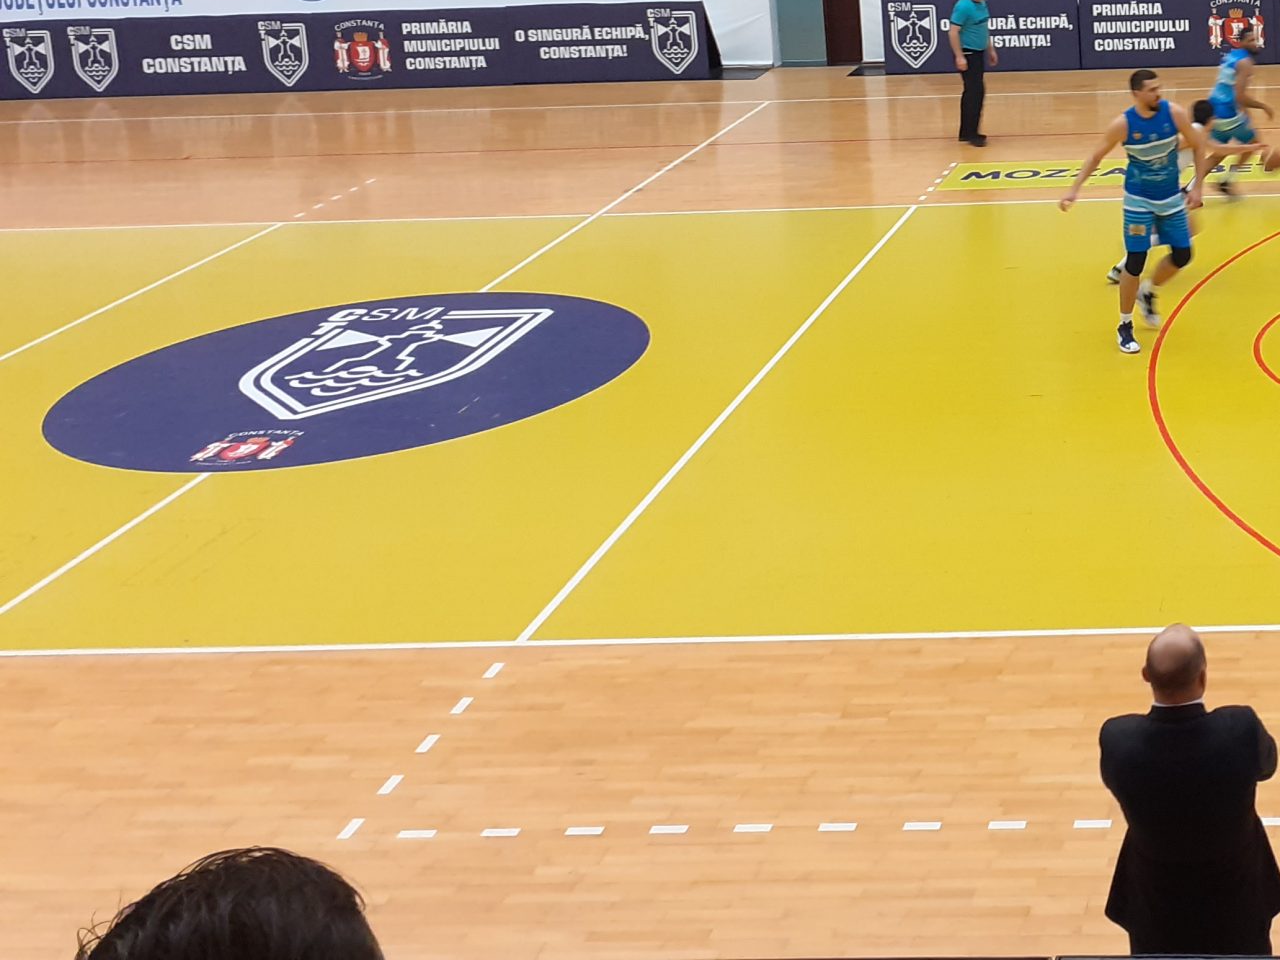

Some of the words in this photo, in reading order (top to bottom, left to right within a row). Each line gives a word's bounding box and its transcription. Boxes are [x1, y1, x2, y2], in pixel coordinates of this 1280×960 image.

[646, 8, 671, 18] CSM
[887, 2, 911, 12] CSM
[1092, 0, 1163, 17] PRIMĂRIA
[257, 21, 282, 31] CSM
[402, 18, 472, 35] PRIMĂRIA
[940, 19, 950, 31] O
[1093, 19, 1190, 34] MUNICIPIULUI
[514, 29, 526, 42] O
[527, 24, 591, 42] SINGURĂ
[170, 33, 212, 51] CSM
[403, 37, 500, 53] MUNICIPIULUI
[990, 34, 1051, 49] STANȚA!
[961, 166, 1126, 181] MOZZA
[327, 306, 445, 321] CSM
